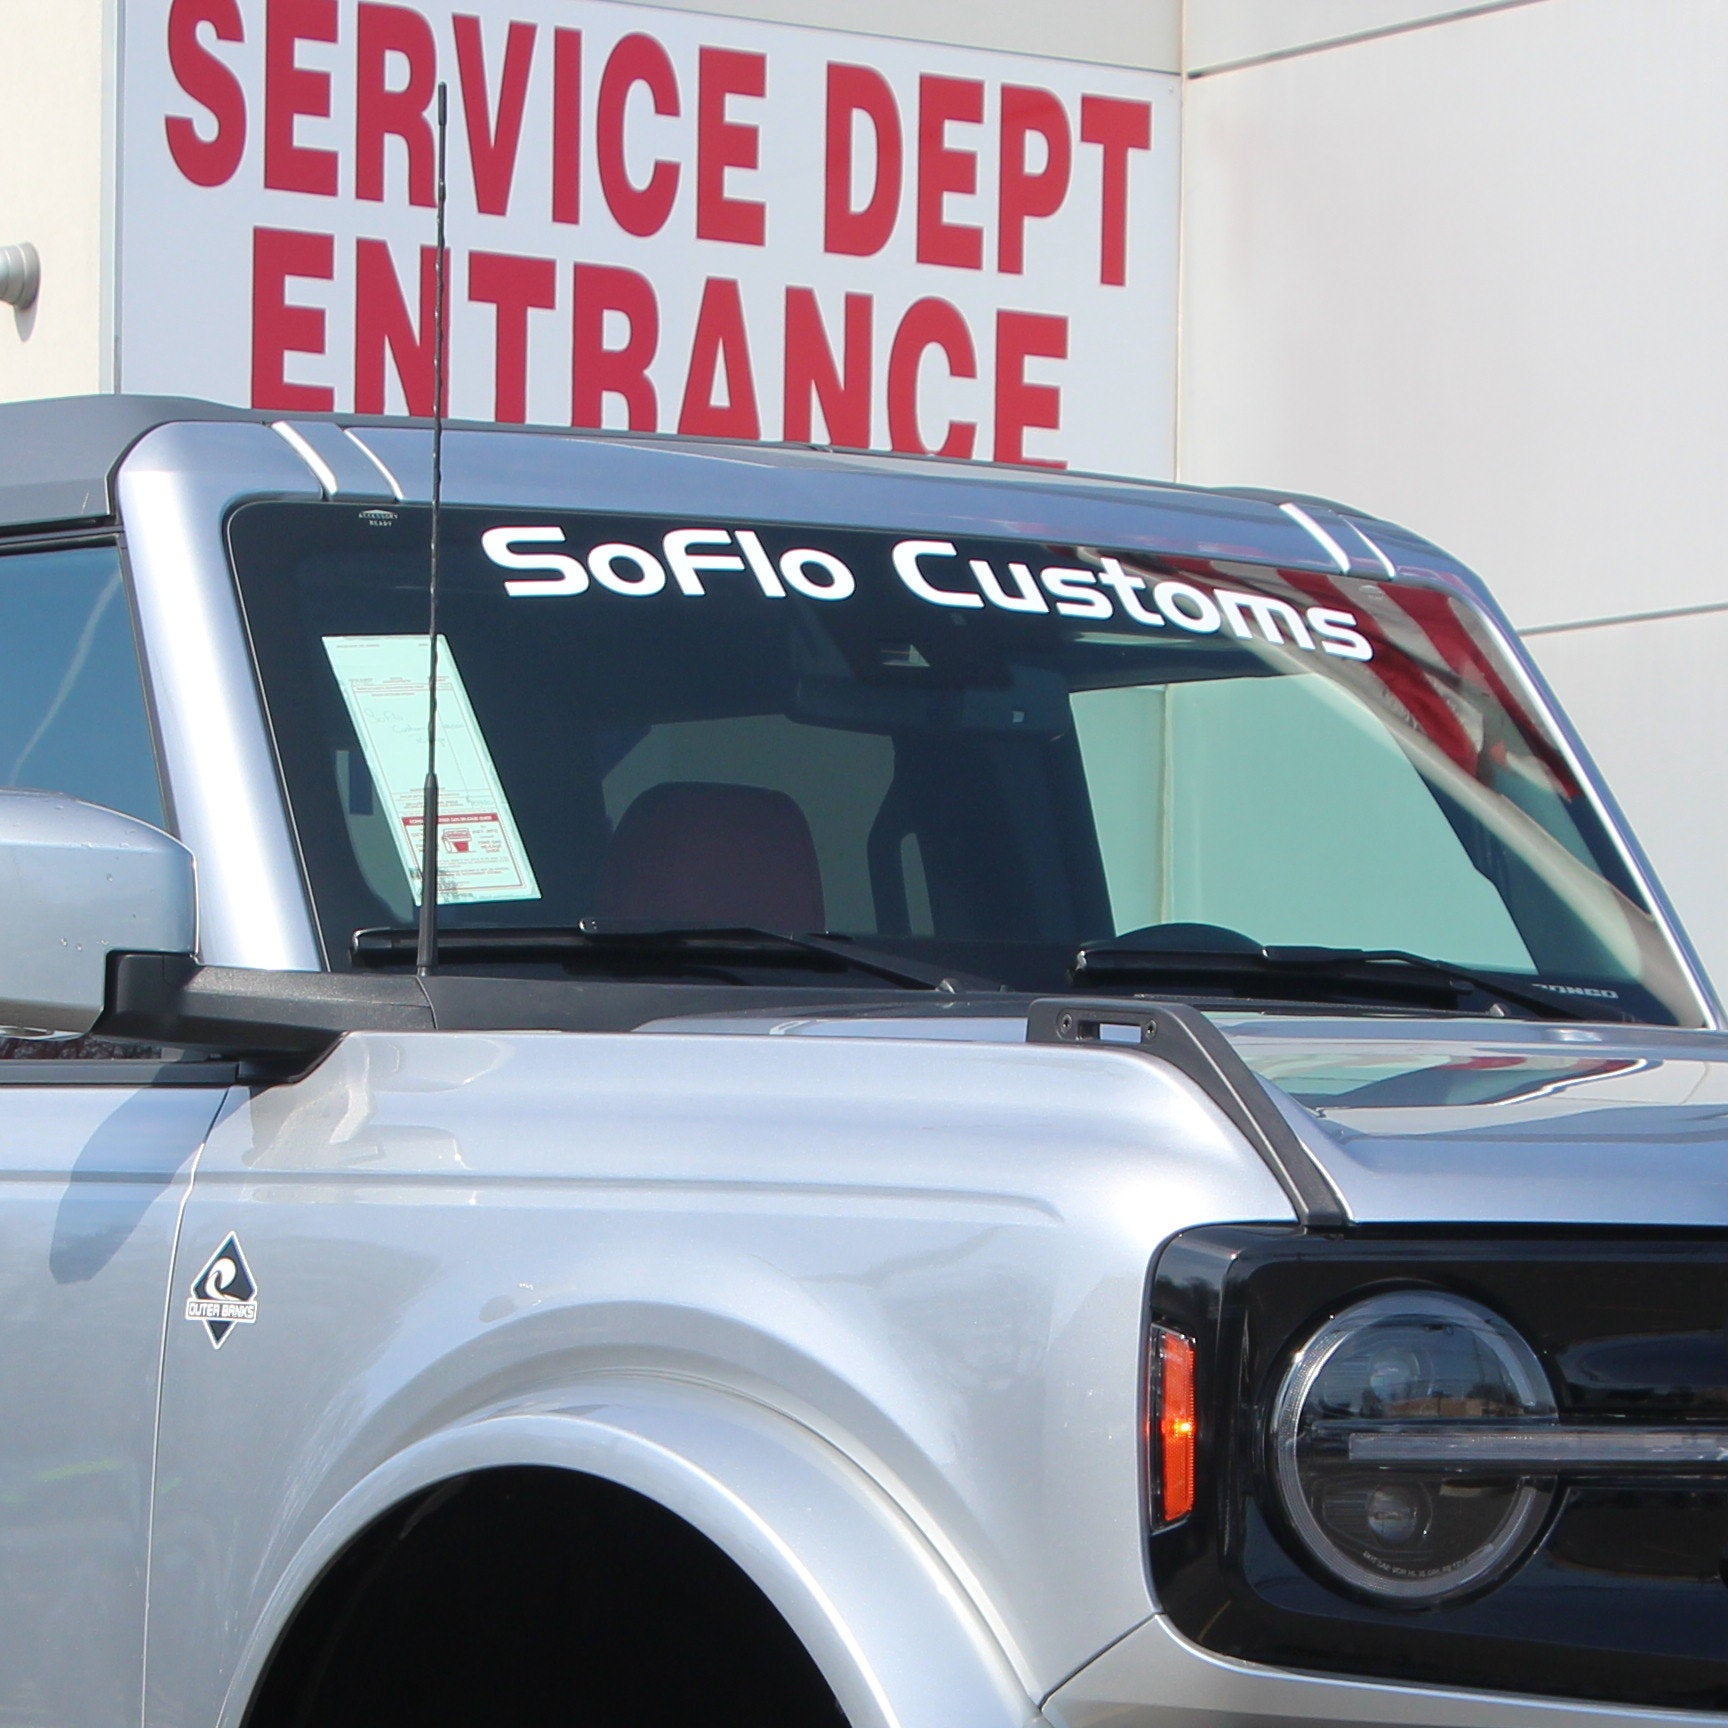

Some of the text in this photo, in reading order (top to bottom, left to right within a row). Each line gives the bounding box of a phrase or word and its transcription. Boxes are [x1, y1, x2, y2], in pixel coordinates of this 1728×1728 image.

[166, 0, 1151, 287] SERVICE DEPT
[251, 228, 1068, 470] ENTRANCE
[481, 526, 1374, 660] SoFlo Customs
[189, 1302, 255, 1319] OUTER BANKS
